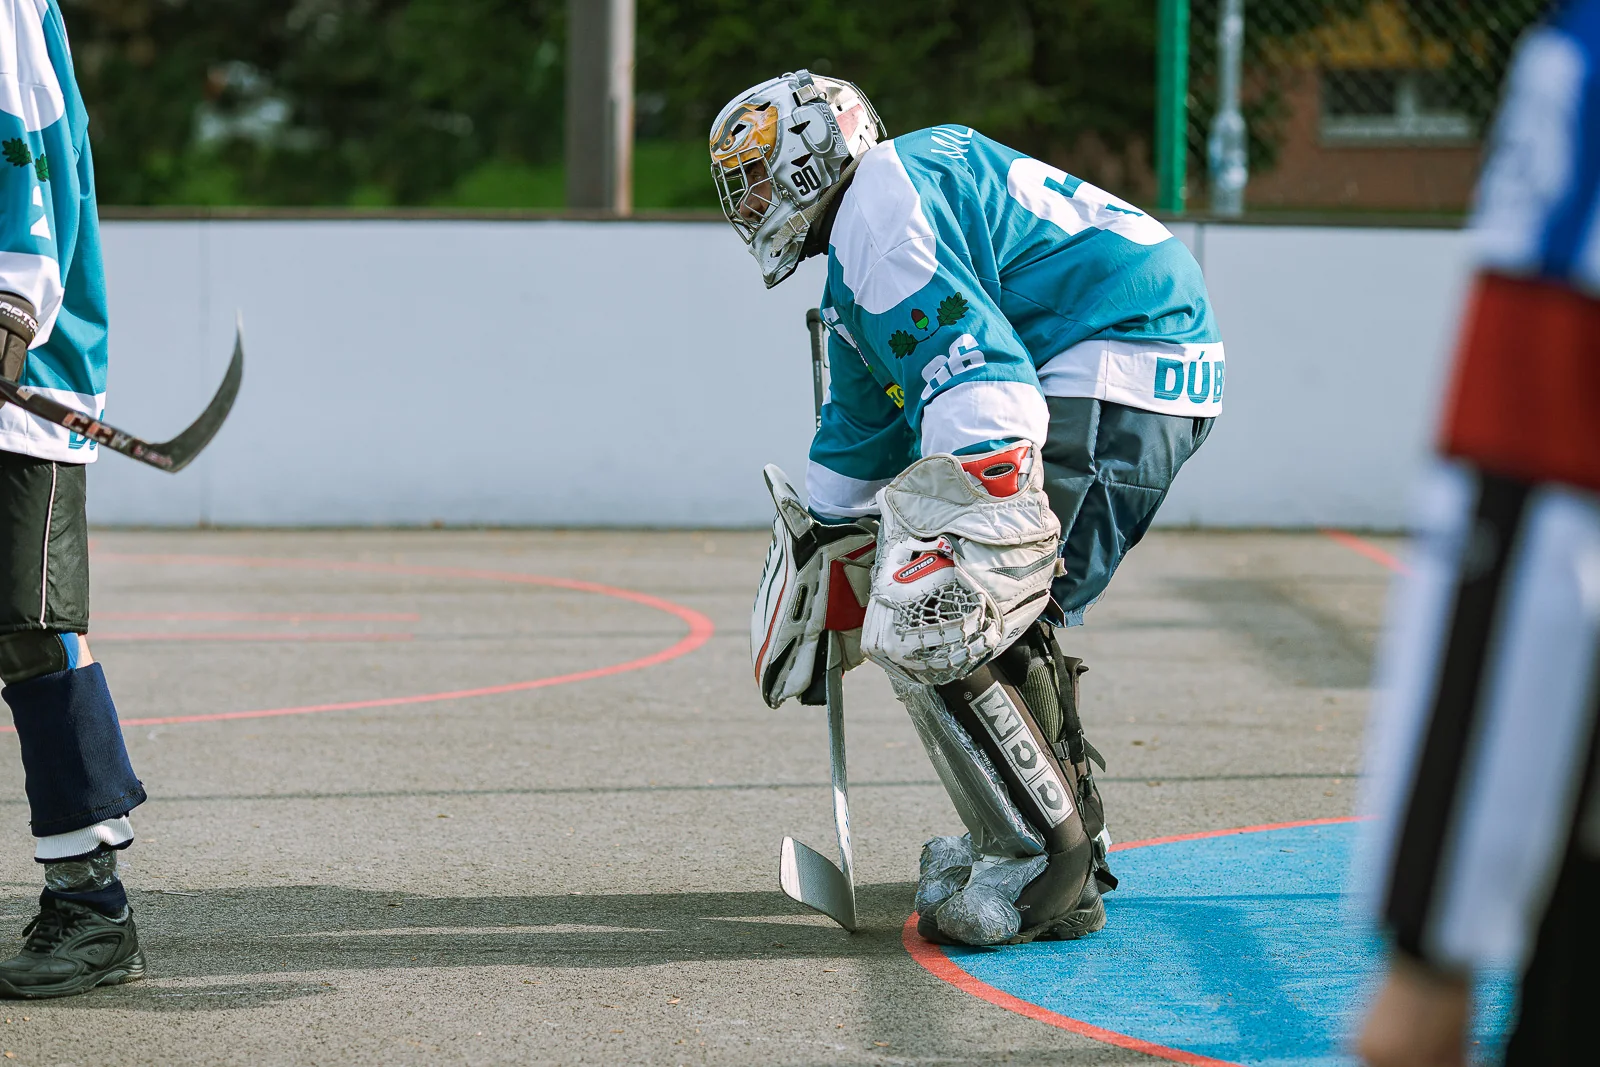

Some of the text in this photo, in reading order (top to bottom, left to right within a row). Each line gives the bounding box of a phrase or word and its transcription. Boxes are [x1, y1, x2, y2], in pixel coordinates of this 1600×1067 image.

[790, 165, 822, 196] 90
[0, 301, 39, 335] APTO
[920, 333, 987, 401] 86
[979, 690, 1065, 812] CCM
